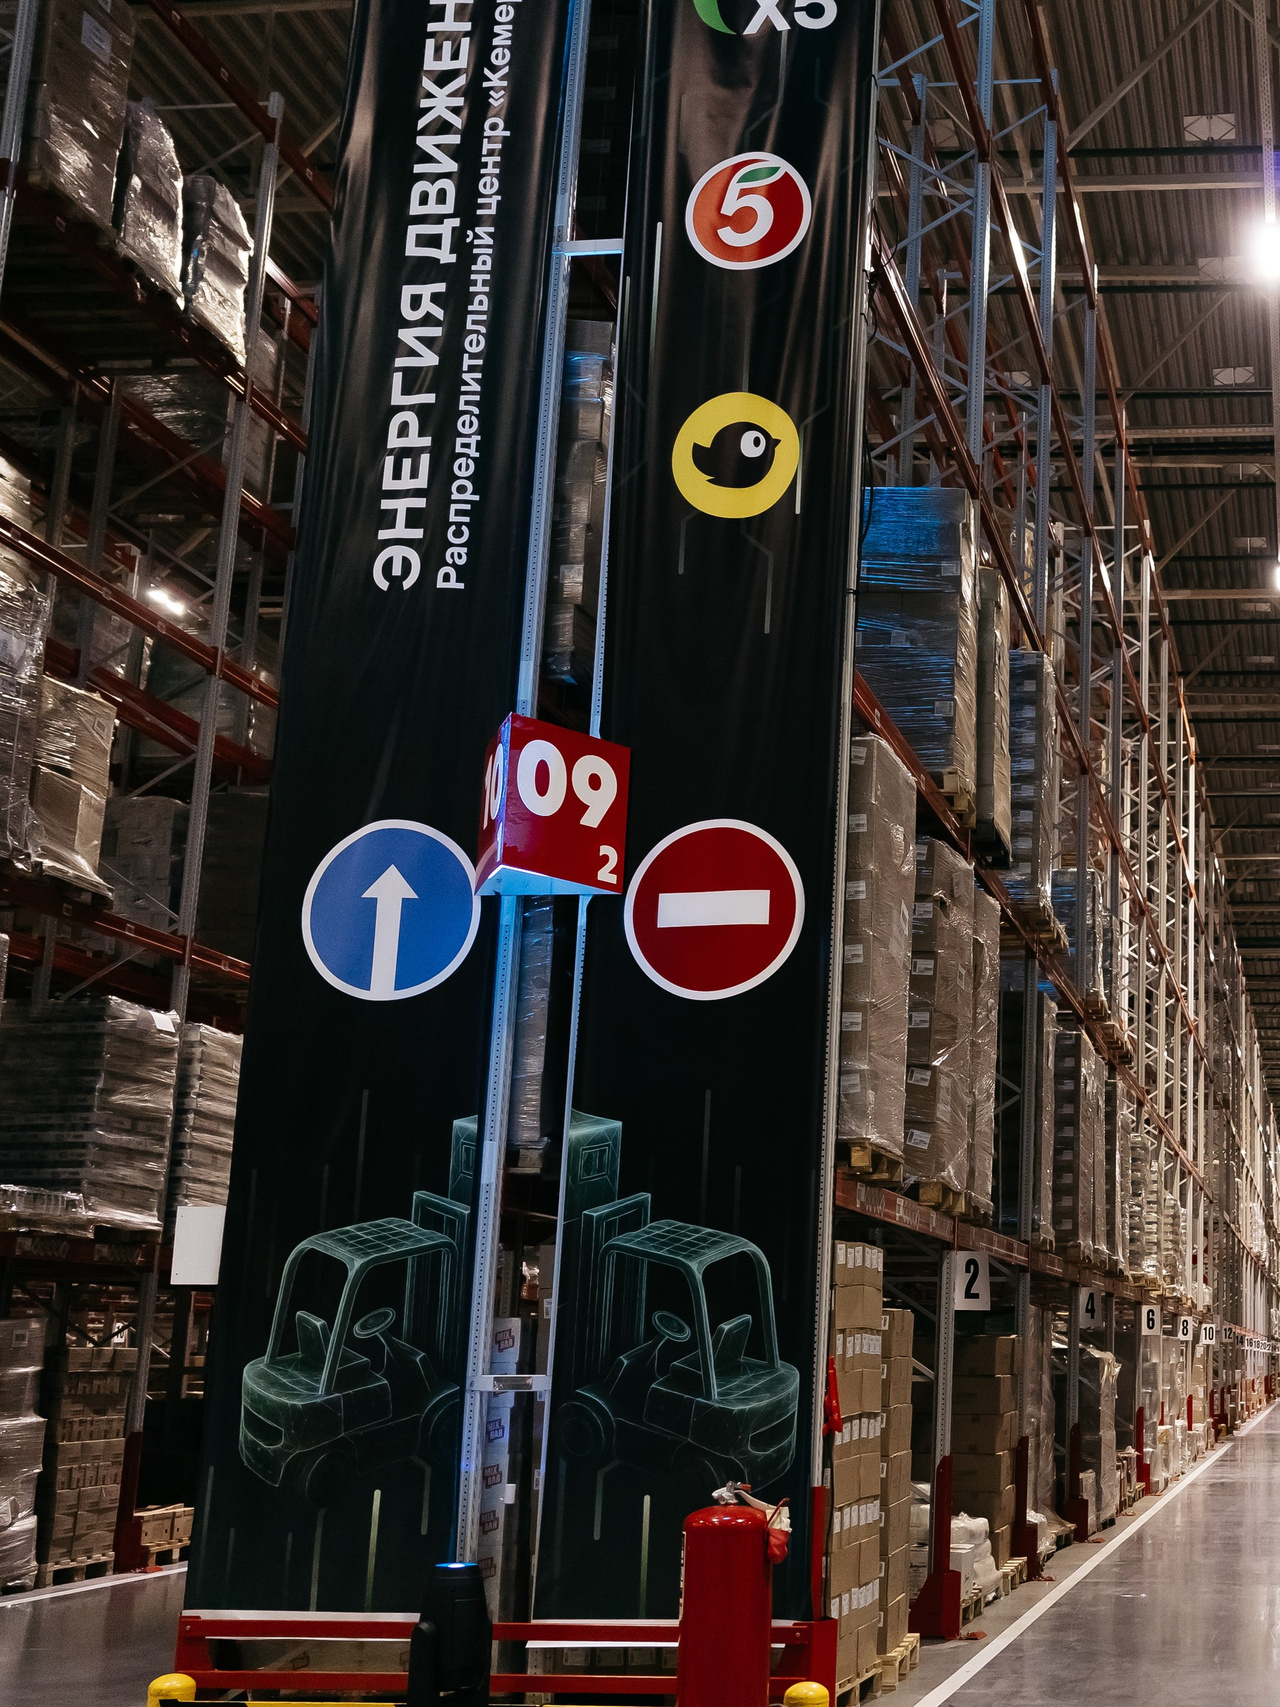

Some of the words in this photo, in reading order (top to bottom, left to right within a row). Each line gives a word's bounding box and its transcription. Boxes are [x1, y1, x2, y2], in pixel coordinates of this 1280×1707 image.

[482, 0, 523, 107] «Кеме
[476, 117, 511, 215] центр
[437, 227, 495, 590] Распределительный
[373, 282, 447, 592] ЭНЕРГИЯ
[482, 742, 504, 831] 10
[516, 739, 618, 829] 09
[597, 844, 619, 885] 2
[963, 1257, 980, 1300] 2
[1084, 1292, 1096, 1320] 4
[1146, 1308, 1155, 1330] 6
[1181, 1319, 1189, 1337] 8
[496, 1331, 510, 1341] MIX
[1203, 1326, 1214, 1341] 10
[1223, 1327, 1233, 1339] 12
[1235, 1335, 1244, 1346] 14
[1246, 1337, 1253, 1347] 16
[1253, 1340, 1260, 1349] 18
[487, 1420, 500, 1431] MIX
[484, 1466, 498, 1477] MIX
[480, 1512, 495, 1523] MIX
